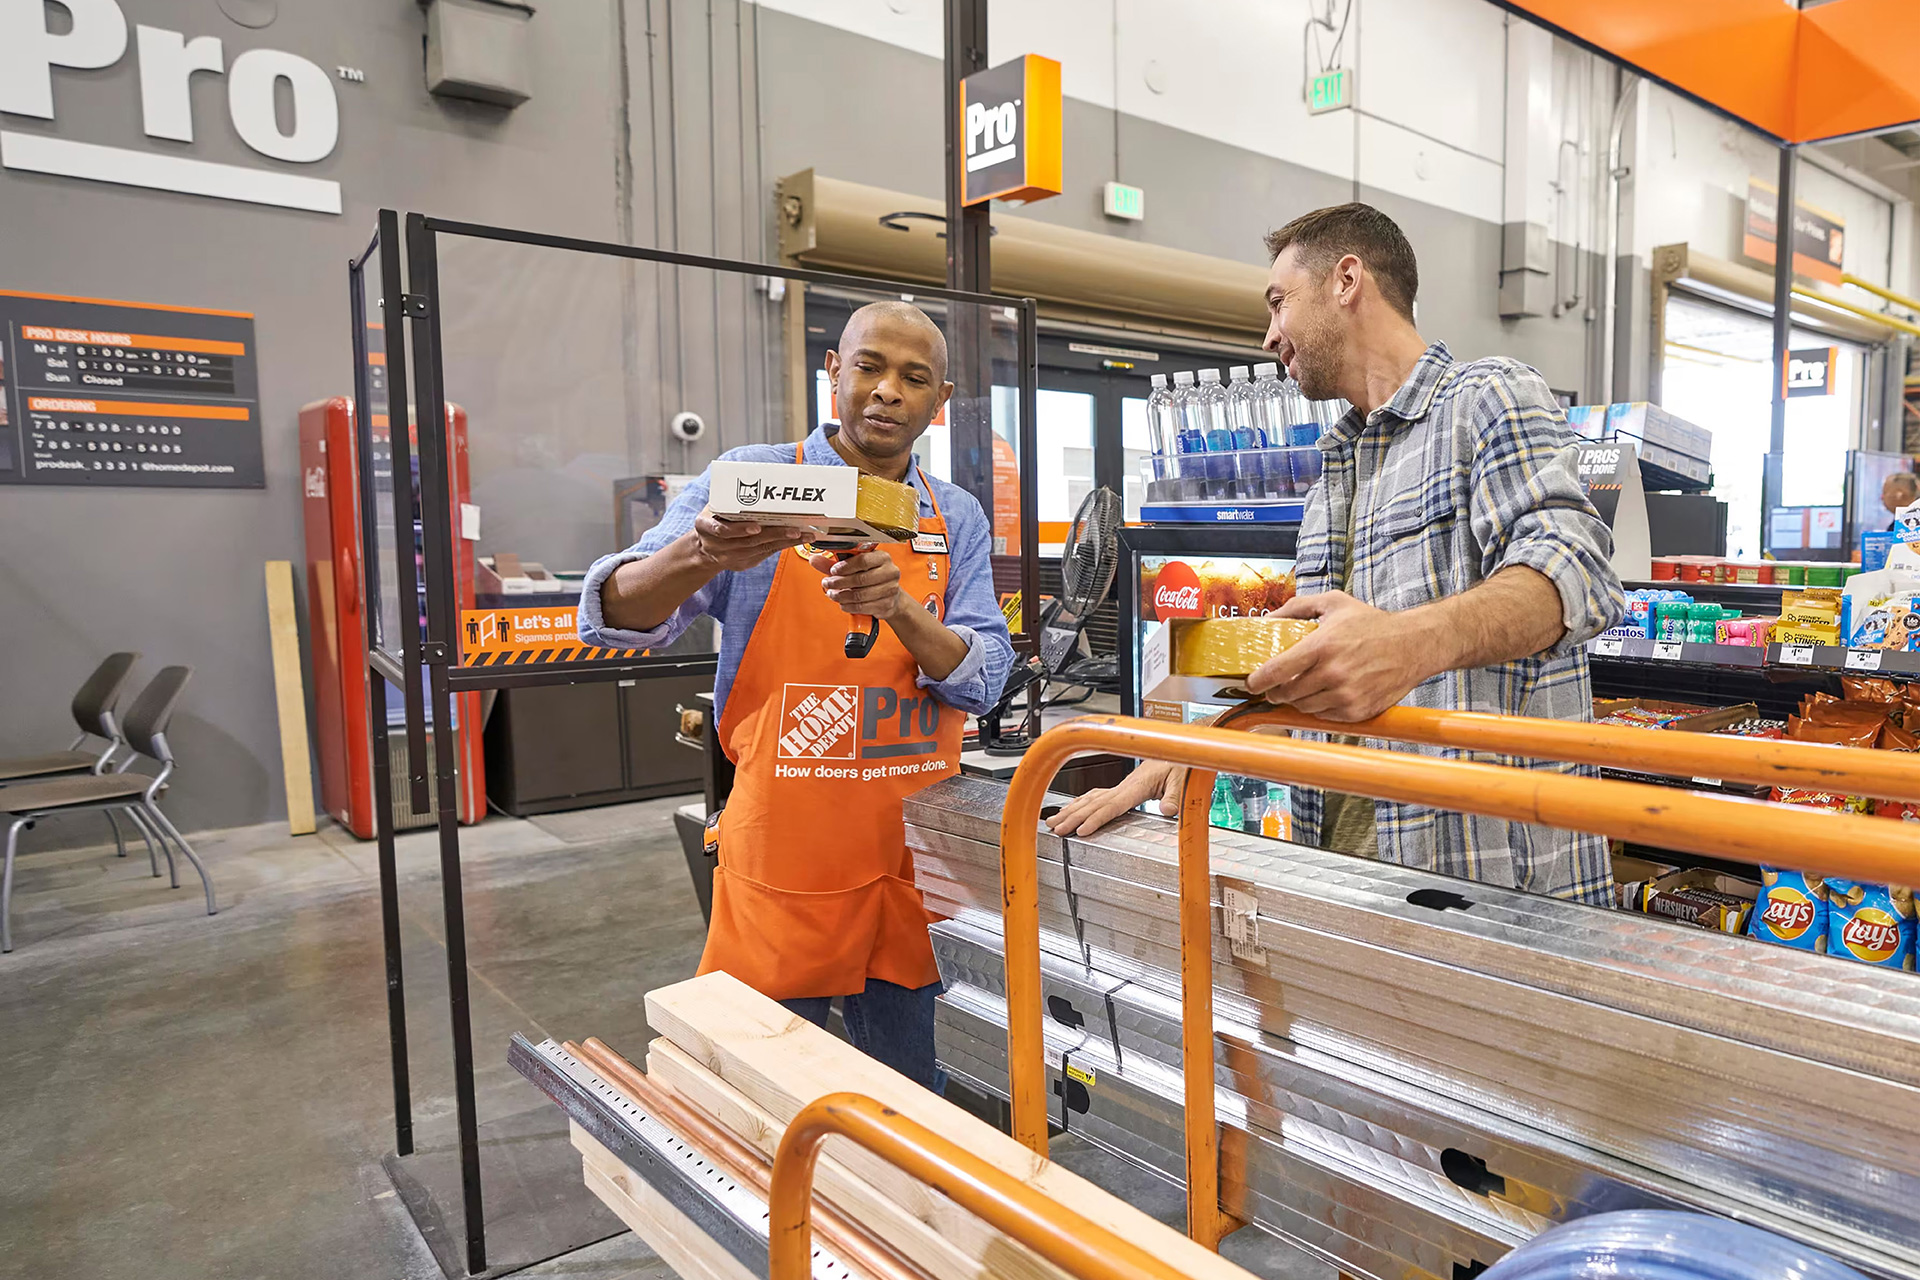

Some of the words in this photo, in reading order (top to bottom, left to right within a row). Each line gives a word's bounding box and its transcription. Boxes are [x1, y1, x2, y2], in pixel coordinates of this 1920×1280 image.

[0, 0, 339, 163] Pro
[1313, 73, 1343, 109] EXIT
[966, 101, 1017, 157] Pro
[1114, 186, 1139, 215] EXIT
[26, 328, 54, 339] PRO
[55, 330, 89, 341] DESK
[82, 374, 124, 387] Closed
[32, 398, 97, 413] ORDERING
[1583, 449, 1621, 464] PROS
[1591, 464, 1617, 475] DONE
[763, 485, 826, 502] K-FLEX
[1155, 585, 1201, 610] Coca-Cola
[514, 614, 552, 630] Let's
[554, 613, 573, 628] all
[1211, 604, 1239, 619] ICE
[514, 632, 553, 644] Sigamos
[789, 692, 821, 721] THE
[862, 686, 940, 740] Pro
[780, 686, 857, 757] HOME
[809, 713, 856, 757] DEPOT
[775, 764, 811, 778] How
[814, 764, 858, 779] doers
[862, 765, 887, 782] get
[888, 764, 919, 776] more
[921, 759, 949, 772] done.
[1654, 896, 1698, 921] HERSHEY'S
[1763, 899, 1811, 930] Lay's
[1847, 918, 1897, 951] Lay's
